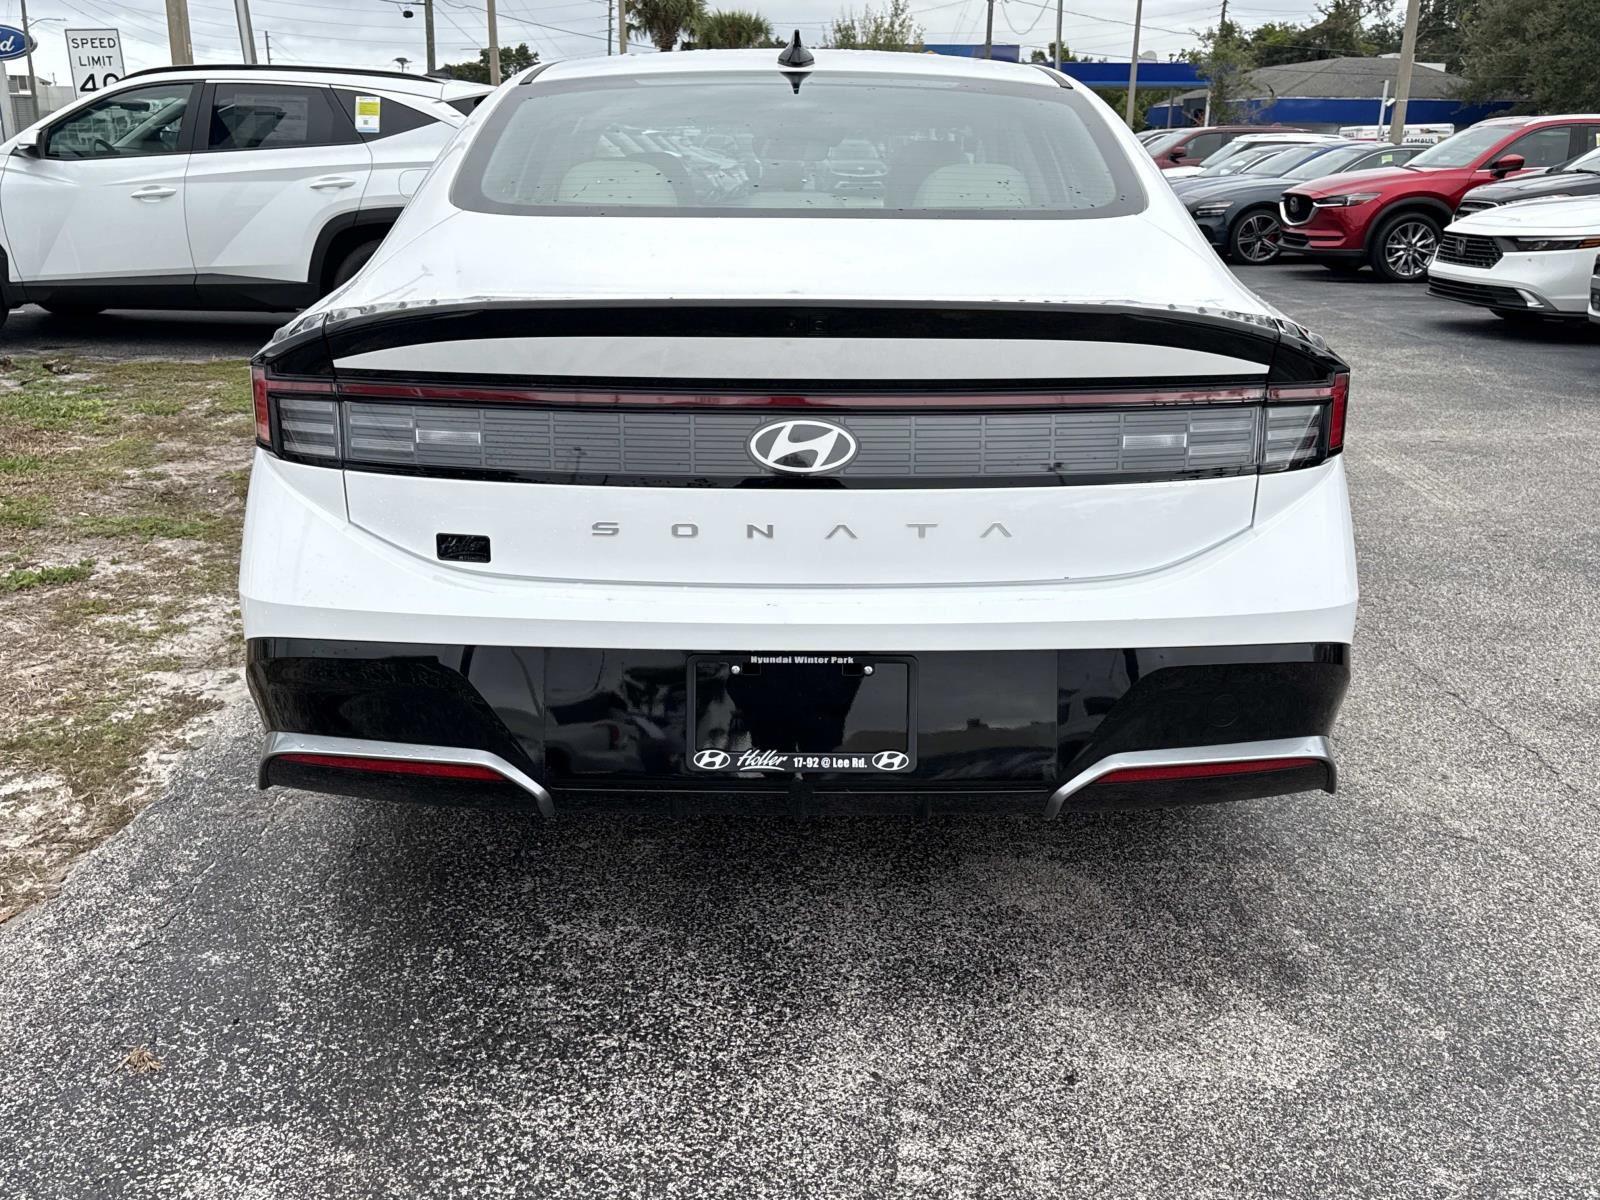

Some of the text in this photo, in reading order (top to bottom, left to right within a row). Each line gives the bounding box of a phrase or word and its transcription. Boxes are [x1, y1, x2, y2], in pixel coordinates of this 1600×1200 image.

[71, 37, 116, 48] SPEED
[78, 55, 113, 67] LIMIT
[591, 521, 1013, 540] SONATA
[750, 655, 855, 664] Hyundai Winter Park
[736, 749, 868, 769] Holler 17-92 @ Lee Rd.
